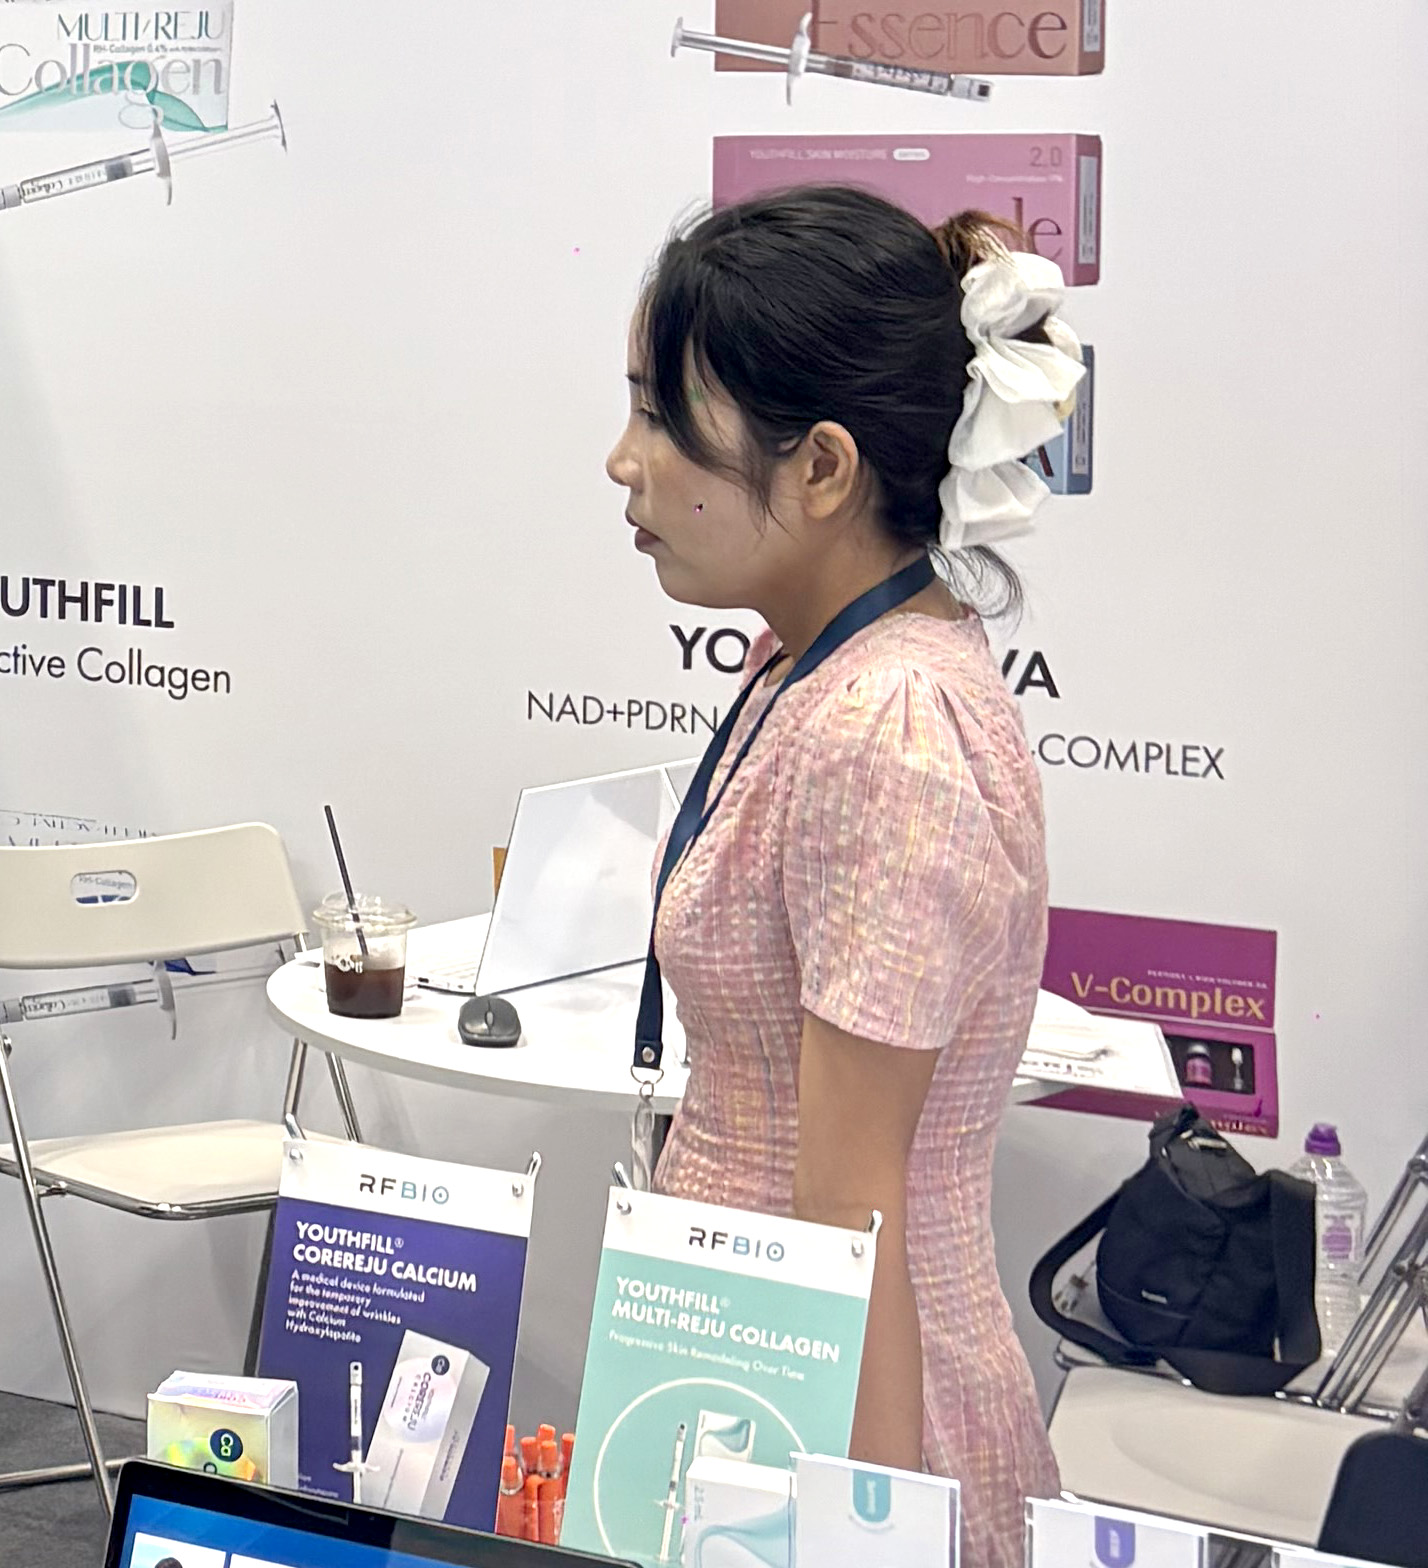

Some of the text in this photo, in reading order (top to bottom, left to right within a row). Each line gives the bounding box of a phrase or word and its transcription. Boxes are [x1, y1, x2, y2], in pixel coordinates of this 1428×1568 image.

[1030, 146, 1063, 168] 2.0
[77, 646, 232, 701] Collagen
[527, 689, 1225, 780] NAD+PDRN COMPLEX
[1070, 971, 1266, 1021] V-Complex
[359, 1173, 449, 1205] RFBIO
[293, 1243, 477, 1293] COREREJU CALCIUM
[688, 1226, 785, 1262] RFBIO
[308, 1310, 346, 1328] Calcium
[611, 1299, 840, 1363] MULTI-REJU COLLAGEN
